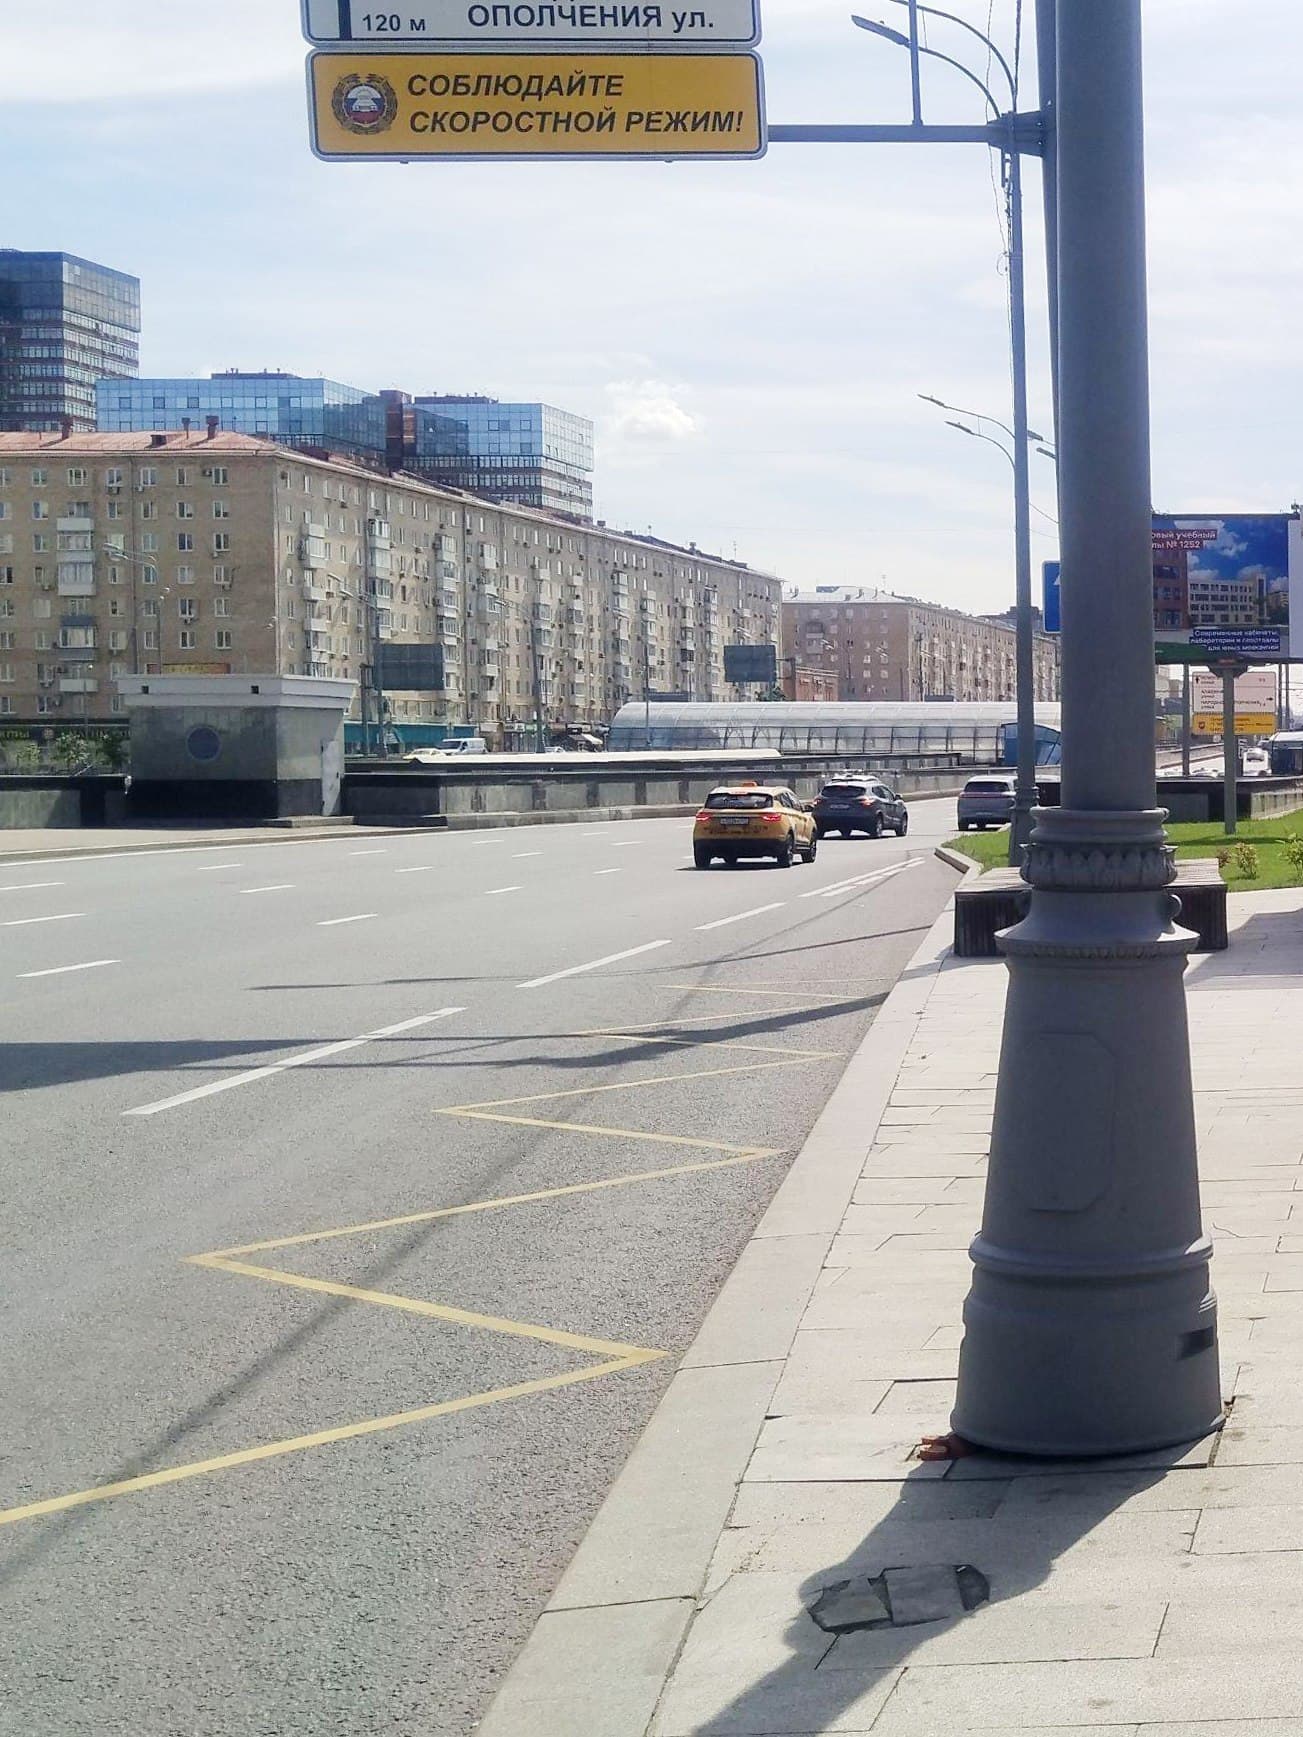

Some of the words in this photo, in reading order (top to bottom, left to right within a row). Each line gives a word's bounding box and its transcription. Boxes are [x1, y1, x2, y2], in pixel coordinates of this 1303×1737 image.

[362, 14, 400, 31] 120
[410, 18, 426, 31] м
[468, 5, 661, 27] ОПОЛЧЕНИЯ
[672, 11, 714, 33] ул.
[407, 70, 624, 101] СОБЛЮДАЙТЕ
[409, 106, 616, 133] СКОРОСТНОЙ
[625, 110, 744, 133] РЕЖИМ!
